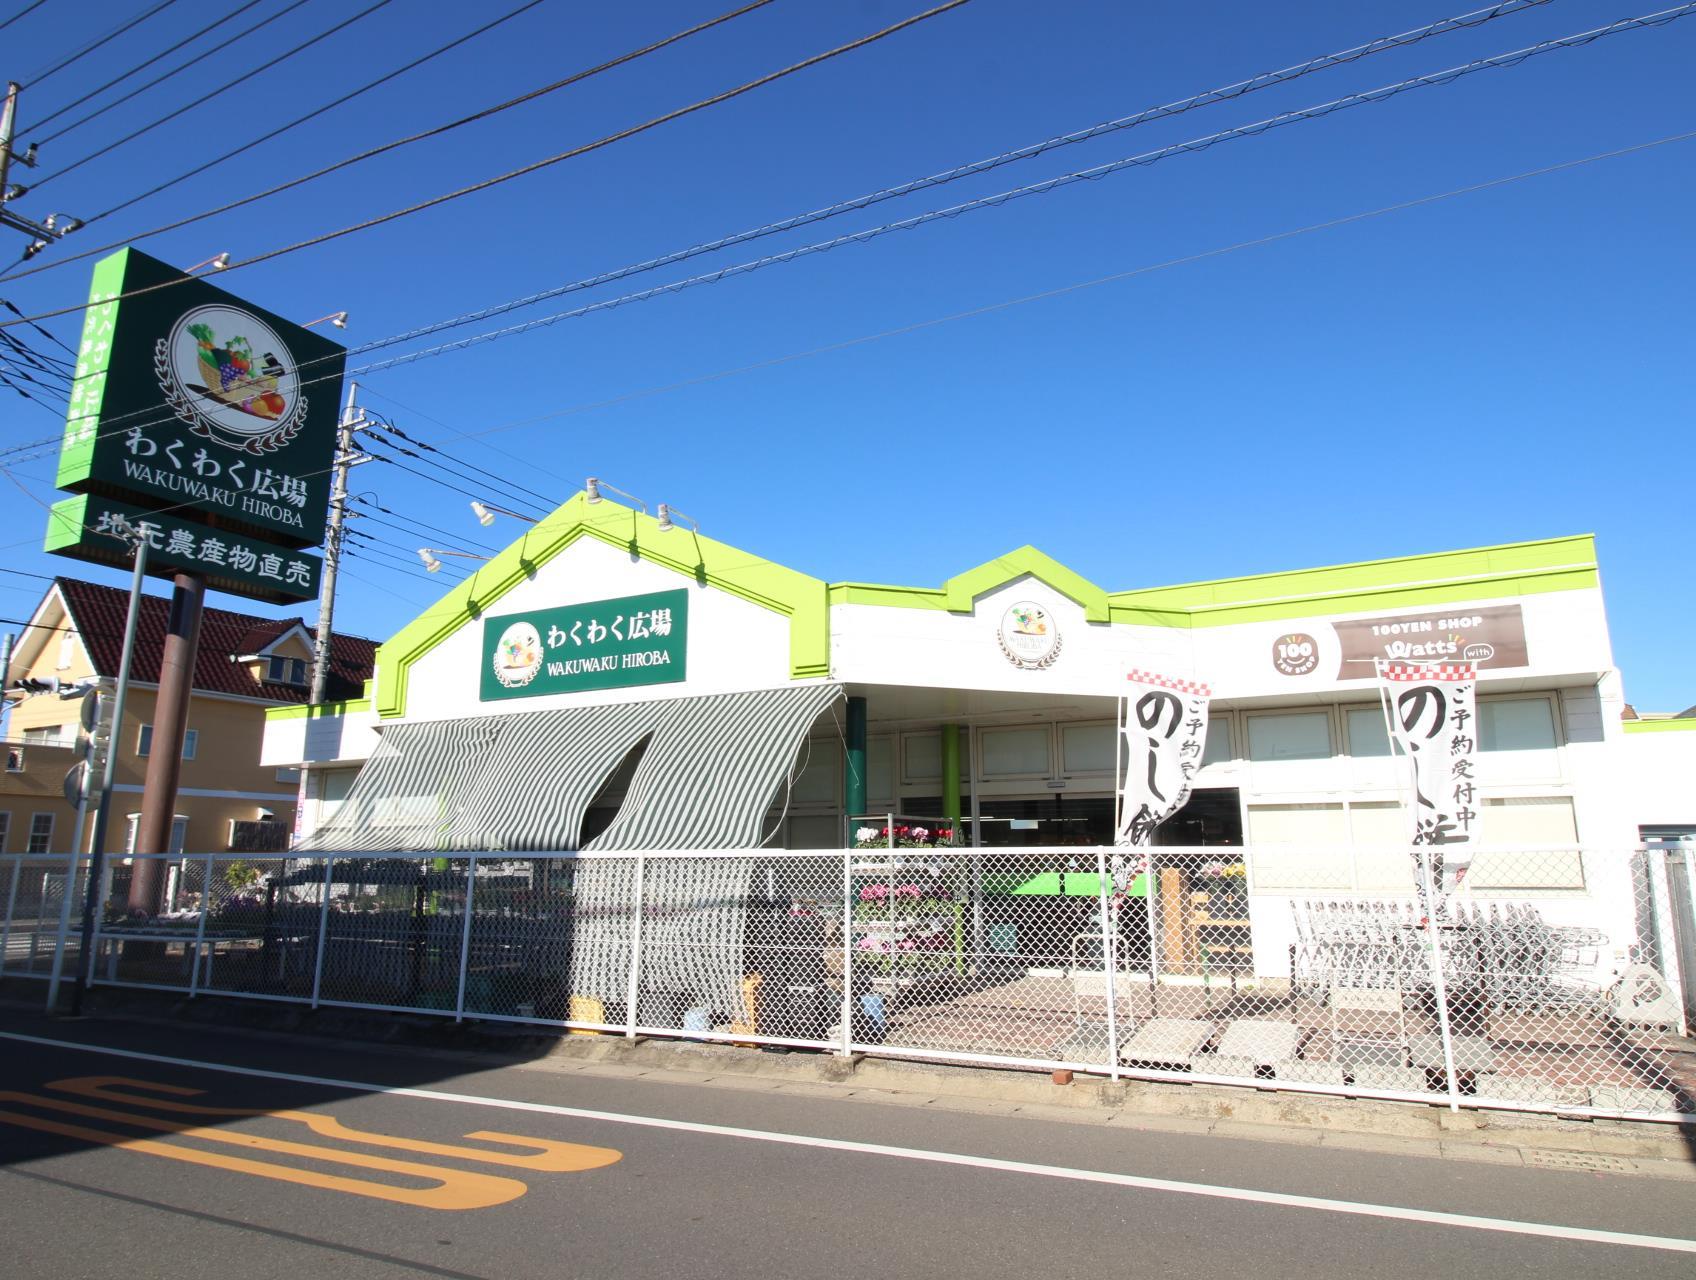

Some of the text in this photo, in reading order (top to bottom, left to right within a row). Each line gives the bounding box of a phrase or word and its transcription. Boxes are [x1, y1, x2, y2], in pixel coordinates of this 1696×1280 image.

[125, 426, 307, 508] わくわく広場
[123, 459, 304, 528] WAKUWAKU HIROBA
[96, 510, 311, 587] 地元農産物直売
[547, 608, 672, 649] わくわく広場
[1372, 616, 1483, 636] 100YEN SHOP
[547, 649, 671, 677] WAKUWAKU HIROBA
[1278, 642, 1313, 658] 100
[1384, 639, 1490, 659] Watts with
[1449, 684, 1477, 833] ご予約受付中
